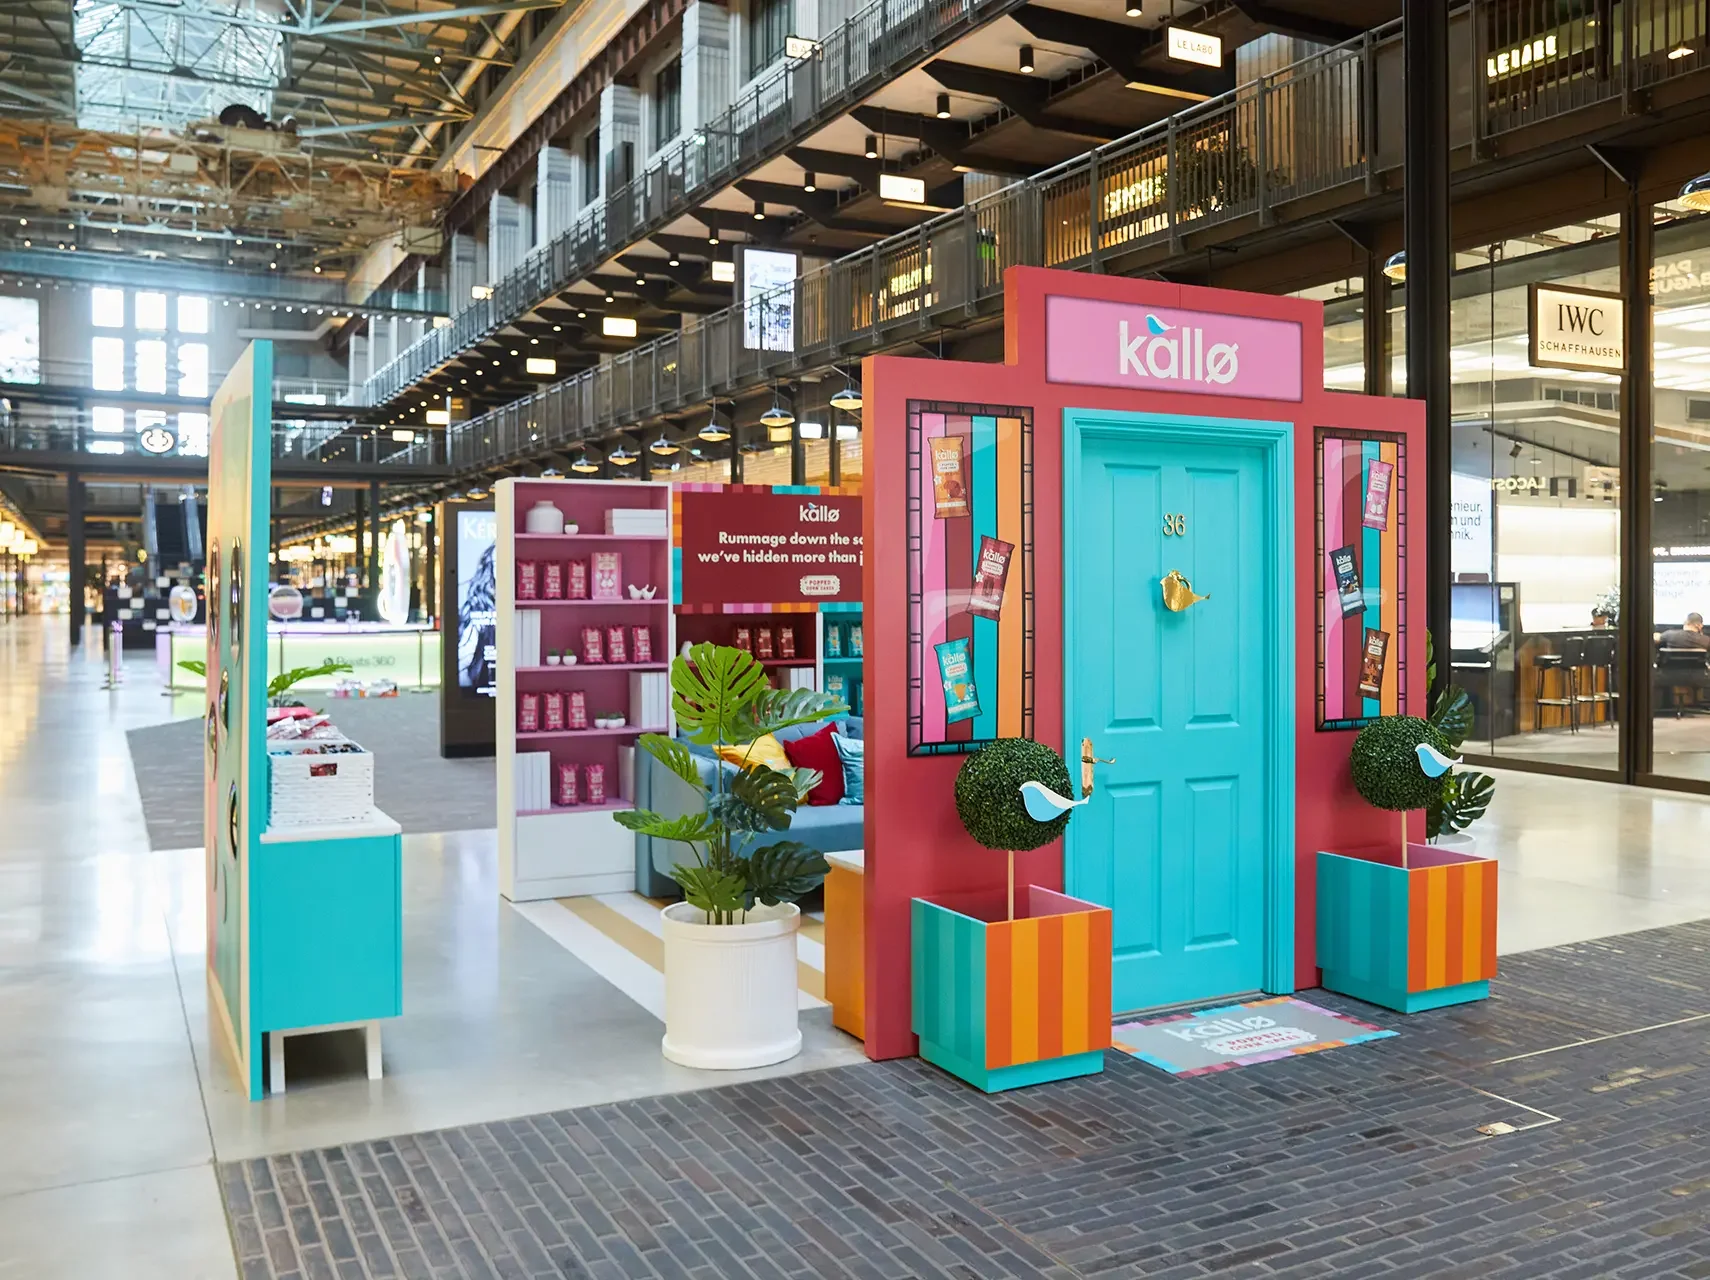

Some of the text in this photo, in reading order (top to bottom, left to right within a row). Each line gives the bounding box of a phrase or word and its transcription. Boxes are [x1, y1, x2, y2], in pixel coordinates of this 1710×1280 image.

[1177, 38, 1188, 50] LE
[1557, 303, 1604, 336] IWC
[1539, 340, 1621, 358] SCHAFFHAUSEN
[1162, 512, 1186, 537] 36
[1460, 514, 1481, 526] und
[718, 531, 787, 547] Rummage
[789, 531, 828, 545] down
[829, 532, 850, 545] the
[697, 549, 740, 563] we’ve
[743, 549, 789, 563] hidden
[791, 552, 826, 563] more
[828, 550, 857, 563] than
